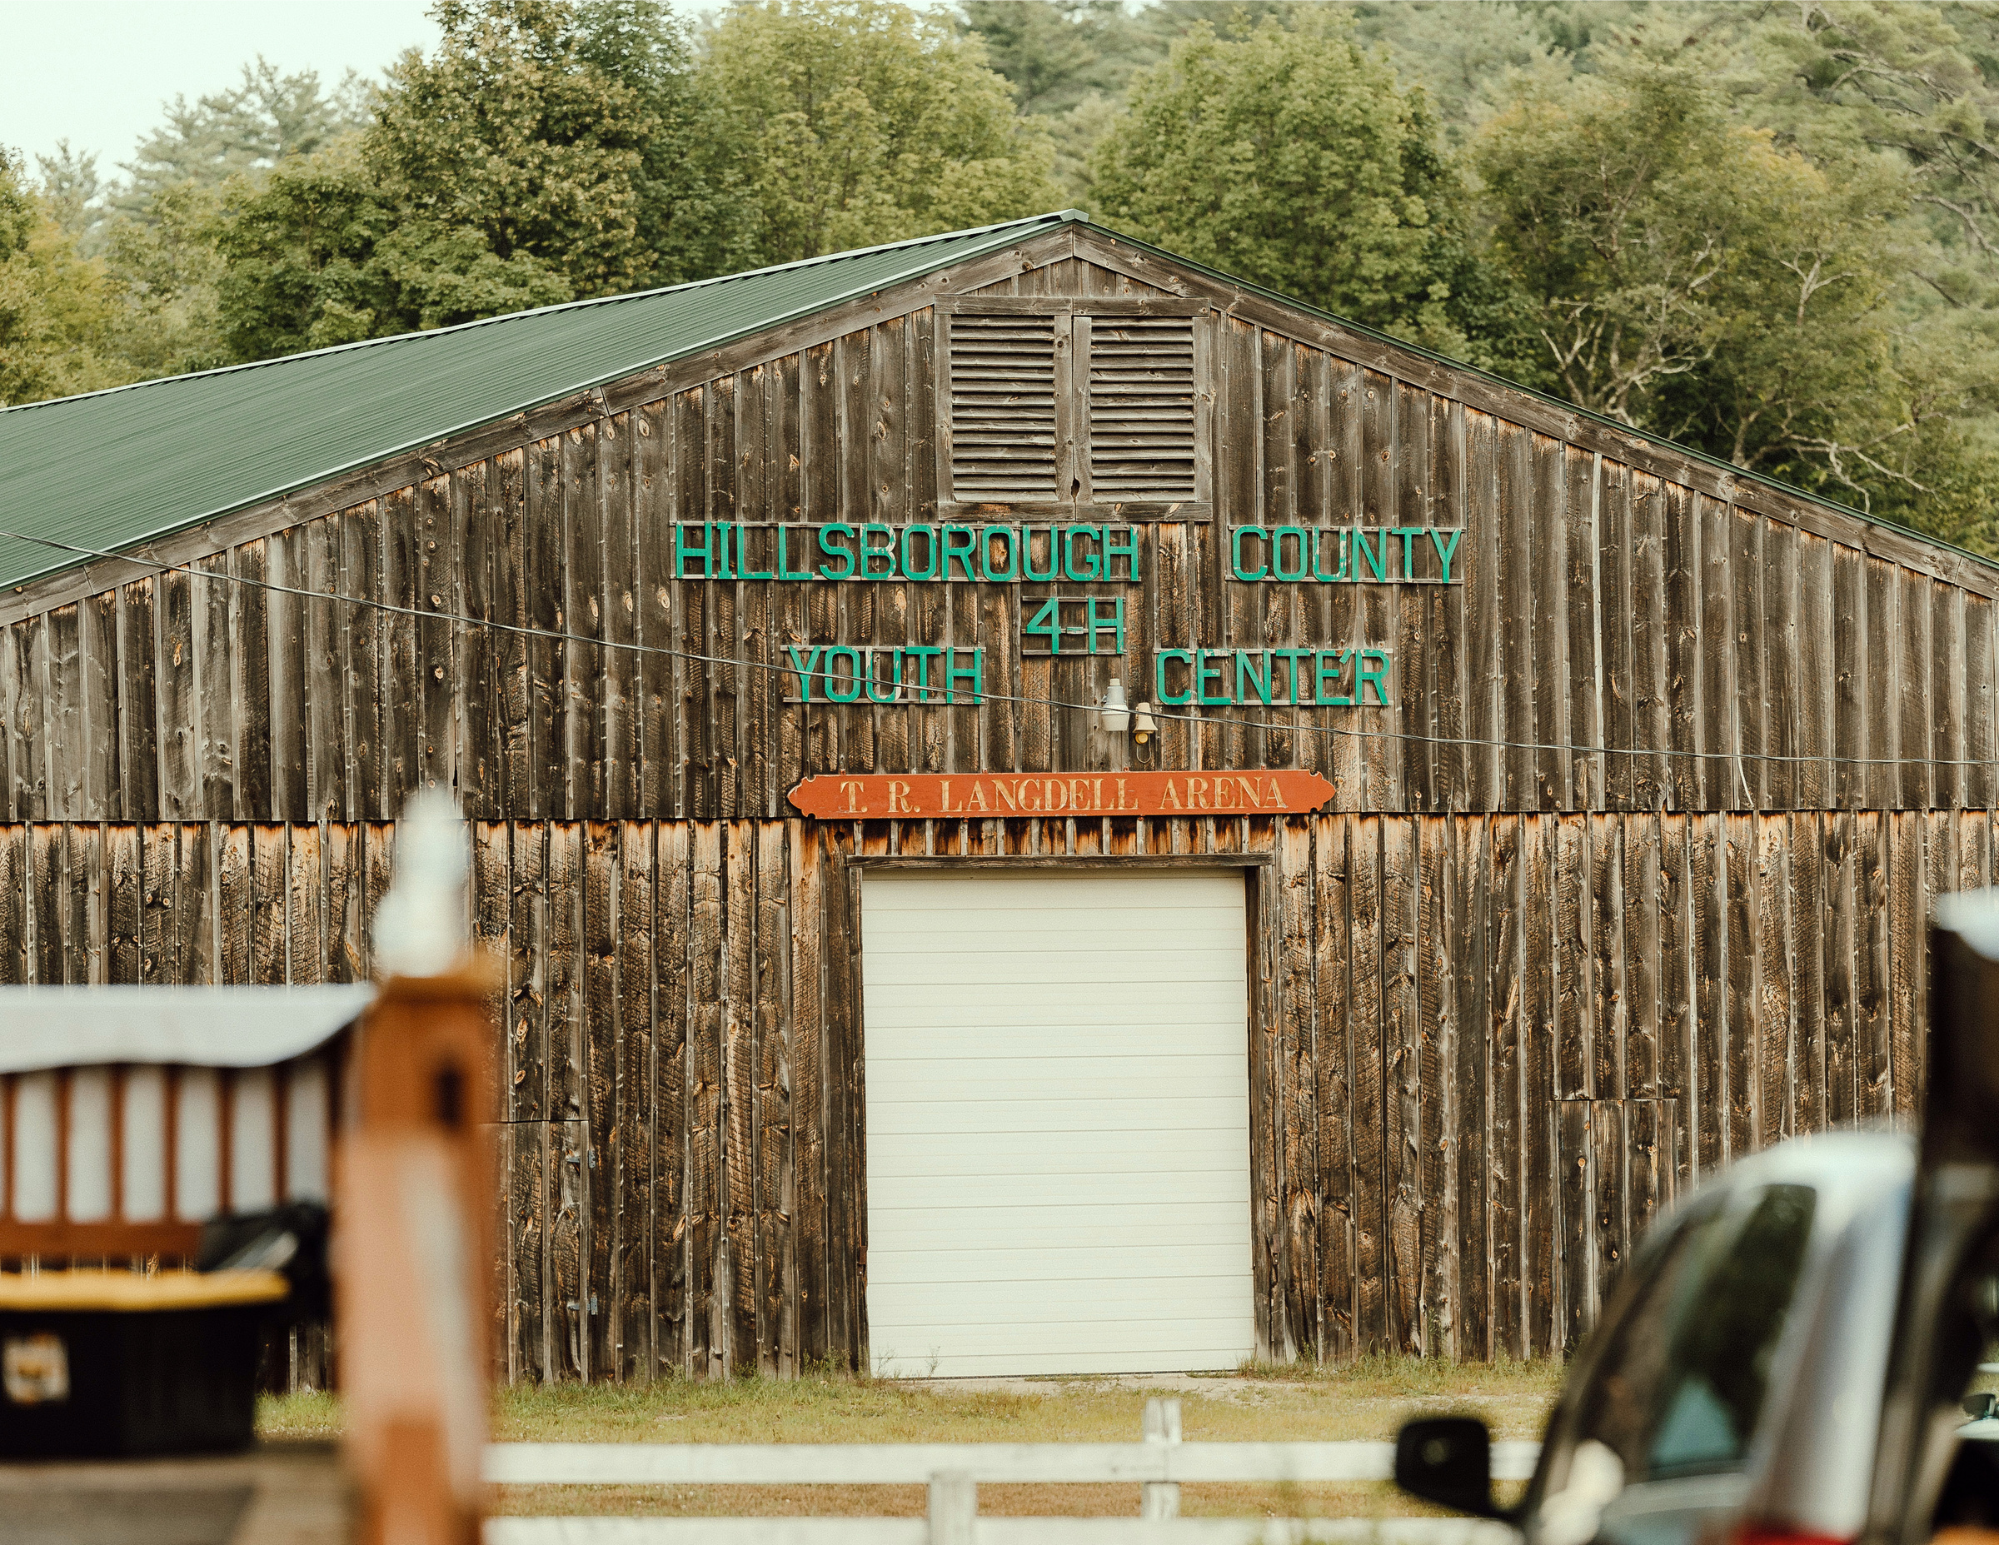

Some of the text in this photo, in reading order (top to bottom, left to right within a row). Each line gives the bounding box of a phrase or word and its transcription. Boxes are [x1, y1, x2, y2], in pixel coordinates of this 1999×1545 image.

[675, 521, 1461, 583] HILLSBOROUGH COUNTY
[1026, 597, 1124, 654] 4-H
[789, 645, 1390, 705] YOUTH CENTER
[840, 776, 1288, 813] T. R. LANGDELL ARENA
